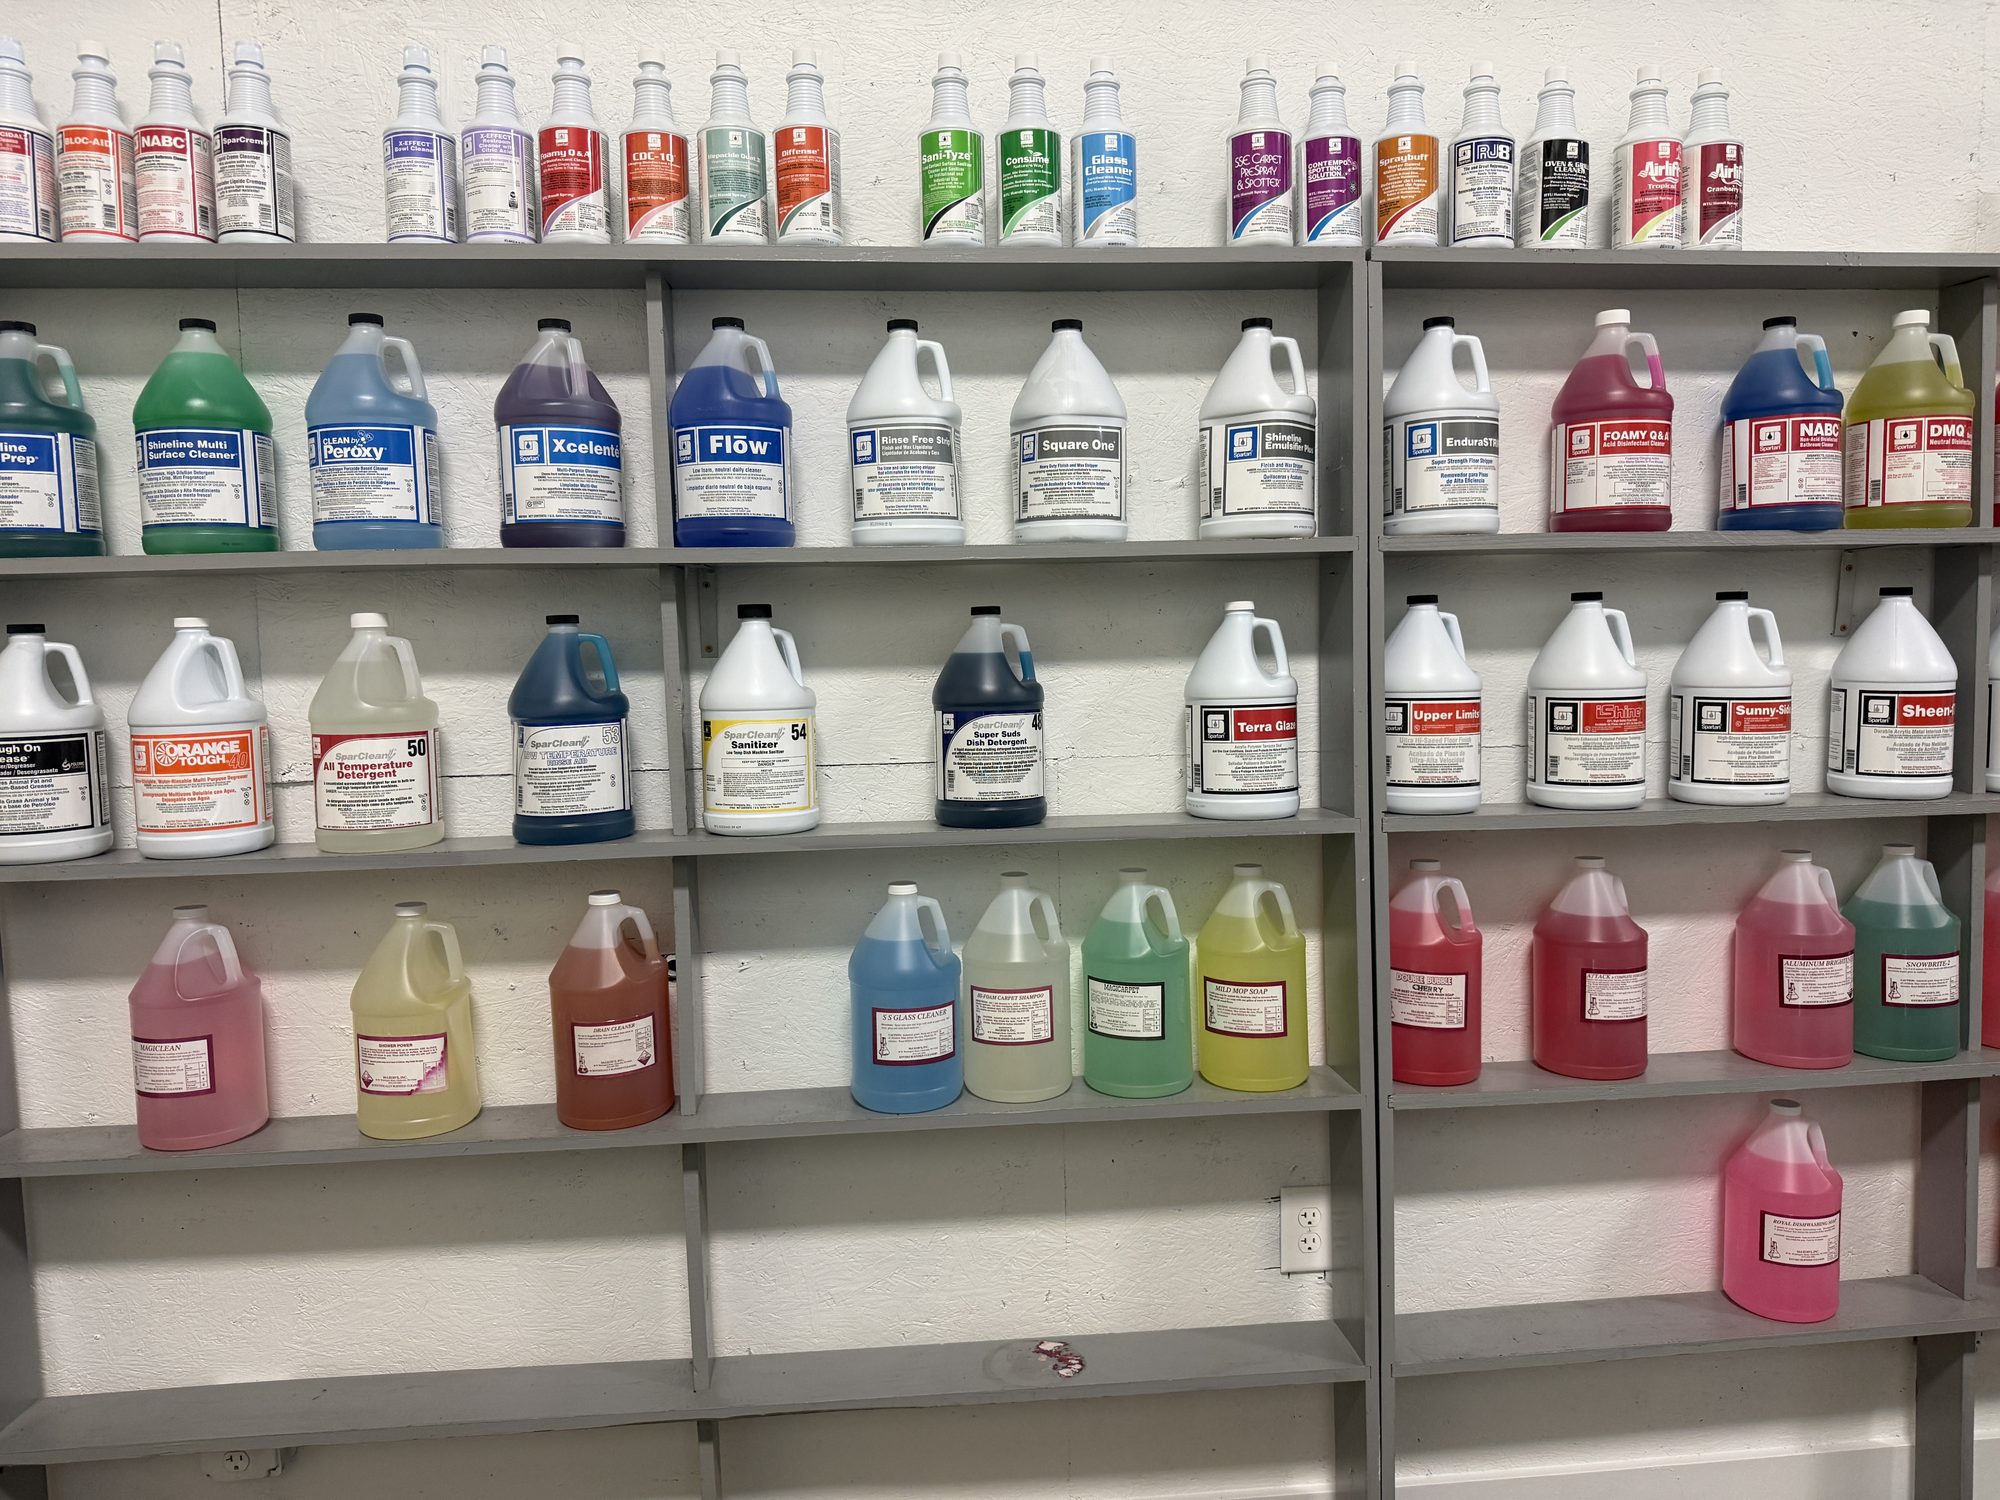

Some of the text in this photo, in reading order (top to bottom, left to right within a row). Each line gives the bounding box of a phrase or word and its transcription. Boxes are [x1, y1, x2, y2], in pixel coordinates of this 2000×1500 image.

[141, 135, 185, 149] NABC
[632, 152, 674, 162] CDC-10
[781, 149, 818, 157] Diffense
[922, 149, 971, 164] Sani-Tyze
[1005, 156, 1050, 166] Consume
[1091, 154, 1128, 166] Glass
[1307, 159, 1348, 169] CONTEMPO
[1085, 166, 1133, 177] Cleaner
[1307, 166, 1342, 174] SPOTTING
[1307, 172, 1342, 180] SOLUTION
[1236, 180, 1245, 191] &
[1800, 422, 1839, 437] NABC
[1929, 424, 1965, 438] DMQ
[881, 436, 908, 445] Rinse
[912, 435, 933, 444] Free
[1603, 430, 1647, 441] FOAMY
[148, 440, 227, 450] Shineline Multi
[322, 437, 359, 446] CLEAN by
[1042, 439, 1114, 452] Square One
[323, 445, 384, 461] Peroxy
[1760, 444, 1781, 452] Spartan
[1, 453, 36, 465] Prep
[149, 449, 236, 460] Surface Cleaner
[1233, 451, 1253, 459] Spartan
[732, 466, 744, 474] daily
[1413, 709, 1480, 721] Upper Limits
[1867, 716, 1890, 724] Spartan
[972, 721, 1020, 730] SparClean
[1237, 722, 1272, 733] Terra
[602, 726, 620, 745] 53
[723, 730, 778, 740] SparClean
[791, 723, 807, 741] 54
[973, 730, 1021, 739] Super Suds
[530, 740, 582, 749] SparClean
[731, 740, 778, 749] Sanitizer
[987, 738, 1028, 746] Detergent
[23, 744, 41, 752] On
[166, 740, 240, 757] ORANGE
[407, 738, 426, 757] 50
[335, 752, 389, 761] SparClean
[540, 747, 617, 759] TEMPERATURE
[179, 755, 226, 766] TOUGH
[323, 761, 413, 772] All Temperature
[337, 769, 397, 780] Detergent
[1103, 984, 1140, 994] MAGICARPET
[1215, 985, 1232, 993] MILD
[1412, 984, 1444, 993] CHERRY
[917, 1009, 947, 1020] CLEANER
[611, 1023, 636, 1032] CLEANER
[140, 1044, 182, 1052] MAGICLEAN
